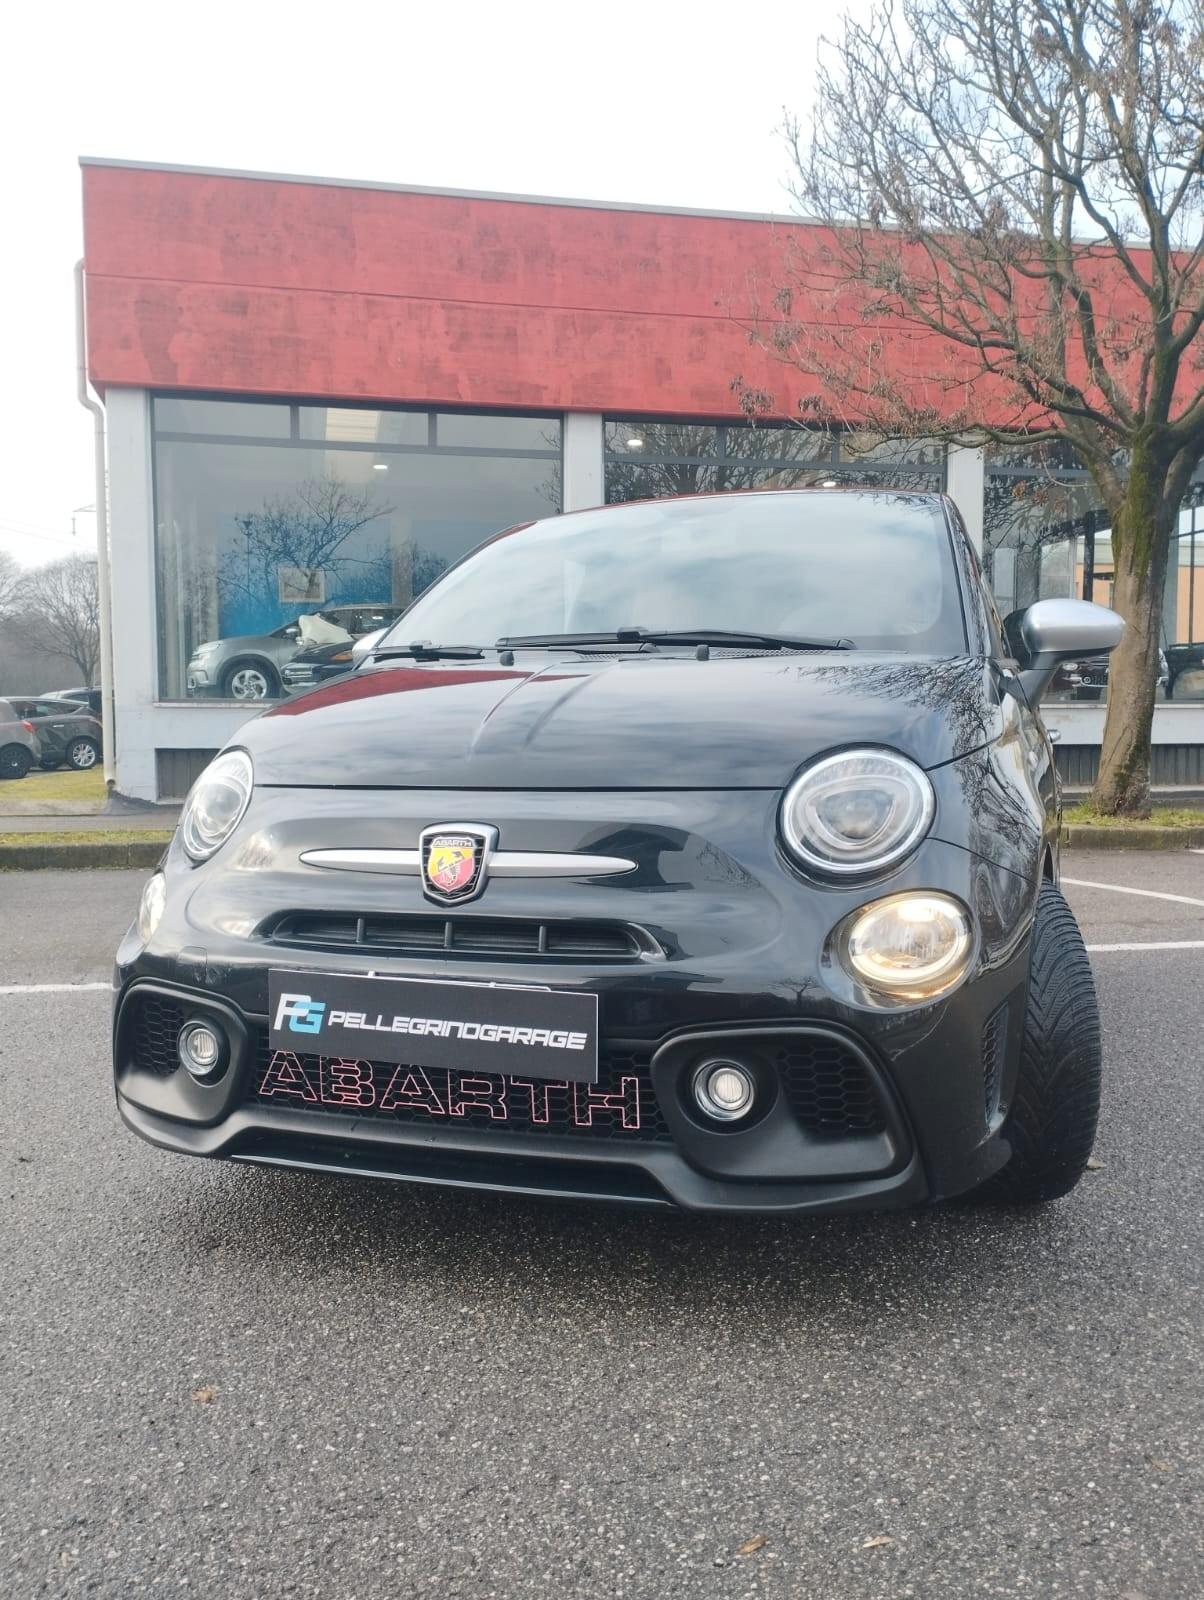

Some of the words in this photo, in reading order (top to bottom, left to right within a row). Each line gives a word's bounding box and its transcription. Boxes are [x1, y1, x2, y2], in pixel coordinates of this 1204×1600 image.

[273, 993, 326, 1034] PG
[328, 1010, 588, 1050] PELLEGRINOGARAGE
[259, 1049, 640, 1129] ABARTH
